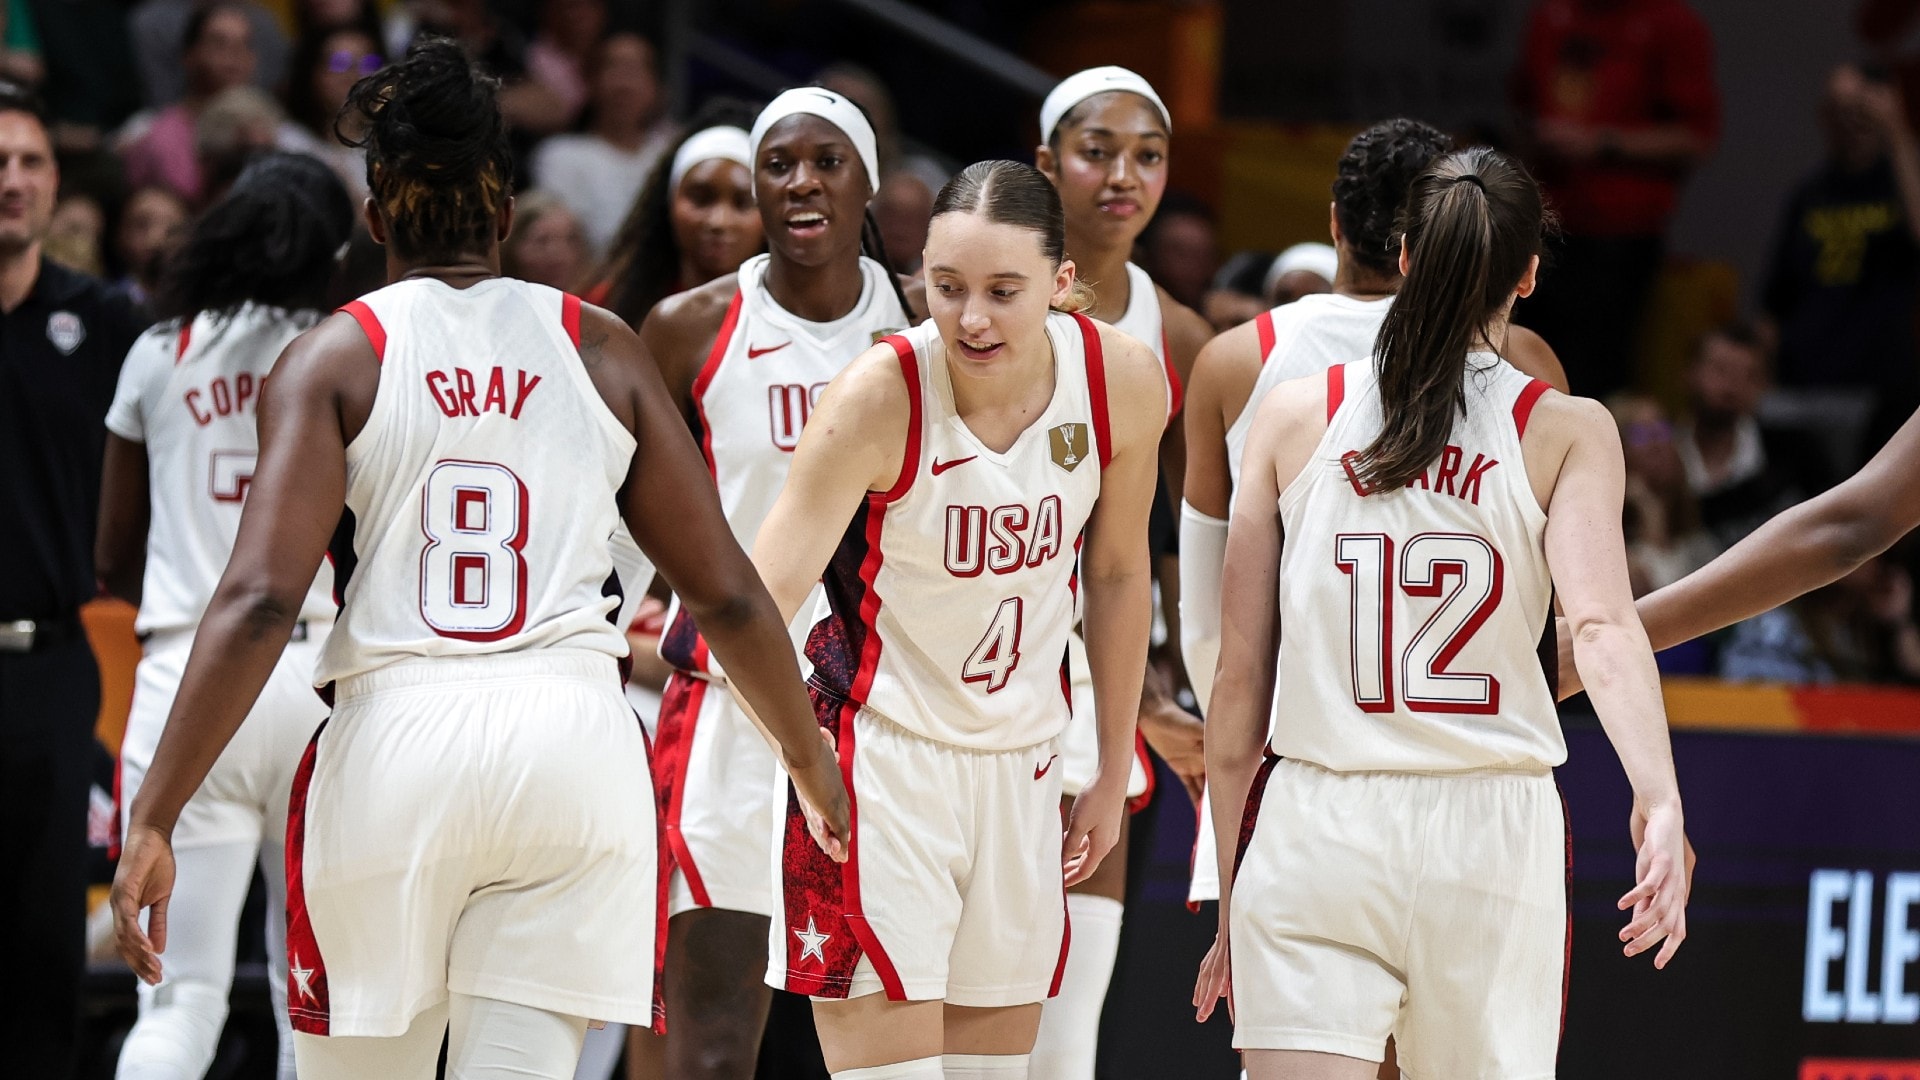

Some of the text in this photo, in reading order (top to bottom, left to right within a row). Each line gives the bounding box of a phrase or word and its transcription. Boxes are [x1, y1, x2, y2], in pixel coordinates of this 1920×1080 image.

[184, 369, 268, 426] COP
[426, 366, 542, 420] GRAY
[1340, 445, 1499, 506] CRK
[419, 459, 529, 642] 8
[944, 495, 1062, 578] USA
[961, 596, 1023, 694] 4
[1335, 532, 1504, 715] 12
